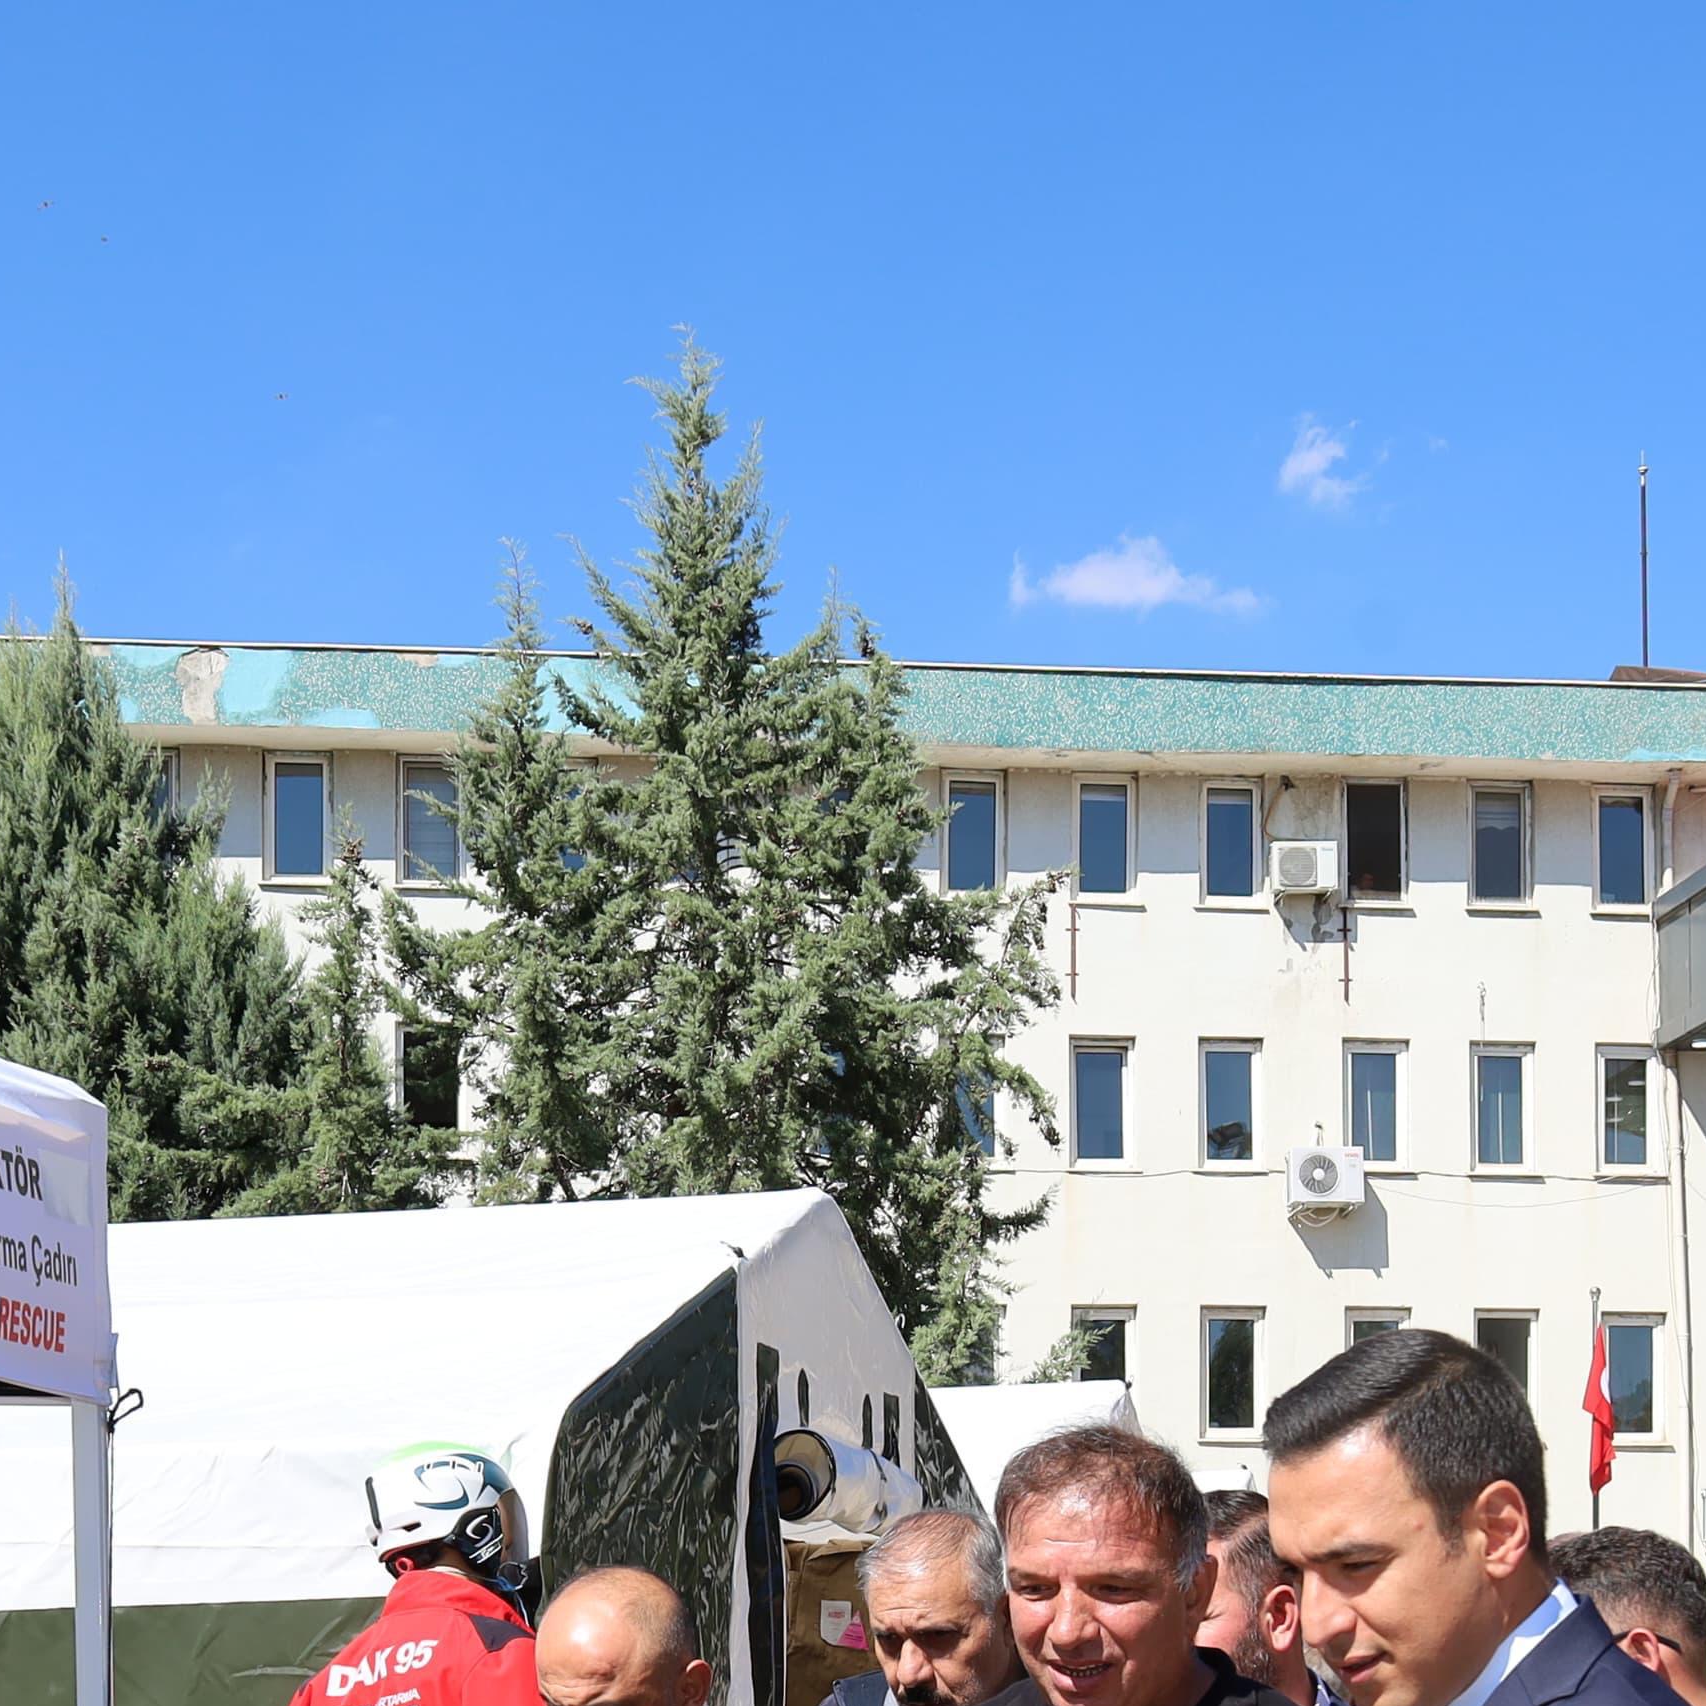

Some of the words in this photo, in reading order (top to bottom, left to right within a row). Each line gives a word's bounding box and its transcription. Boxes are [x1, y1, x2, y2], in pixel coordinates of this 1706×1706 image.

[31, 1234, 78, 1288] Çadırı
[326, 1645, 395, 1697] DAK
[394, 1639, 439, 1674] 95
